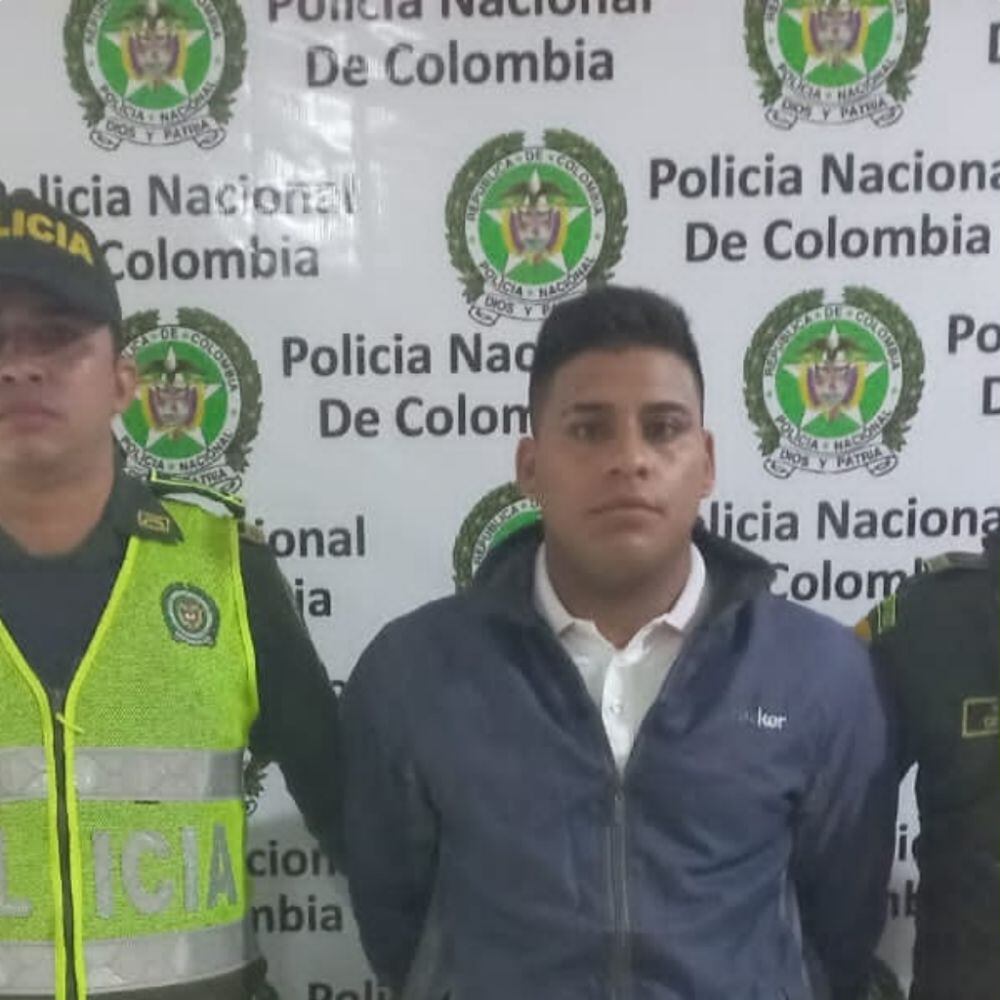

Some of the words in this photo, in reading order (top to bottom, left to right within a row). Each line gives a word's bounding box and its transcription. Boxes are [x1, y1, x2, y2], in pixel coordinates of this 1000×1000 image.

[306, 45, 369, 88] De
[385, 38, 614, 86] Colombia
[149, 173, 356, 217] Nacional
[649, 154, 802, 199] Policia
[821, 149, 1000, 194] Naciona
[686, 221, 747, 263] De
[763, 213, 991, 262] Colombia
[281, 332, 431, 378] Policia
[319, 398, 380, 438] De
[395, 393, 531, 437] Colom
[817, 497, 1000, 541] Naciona
